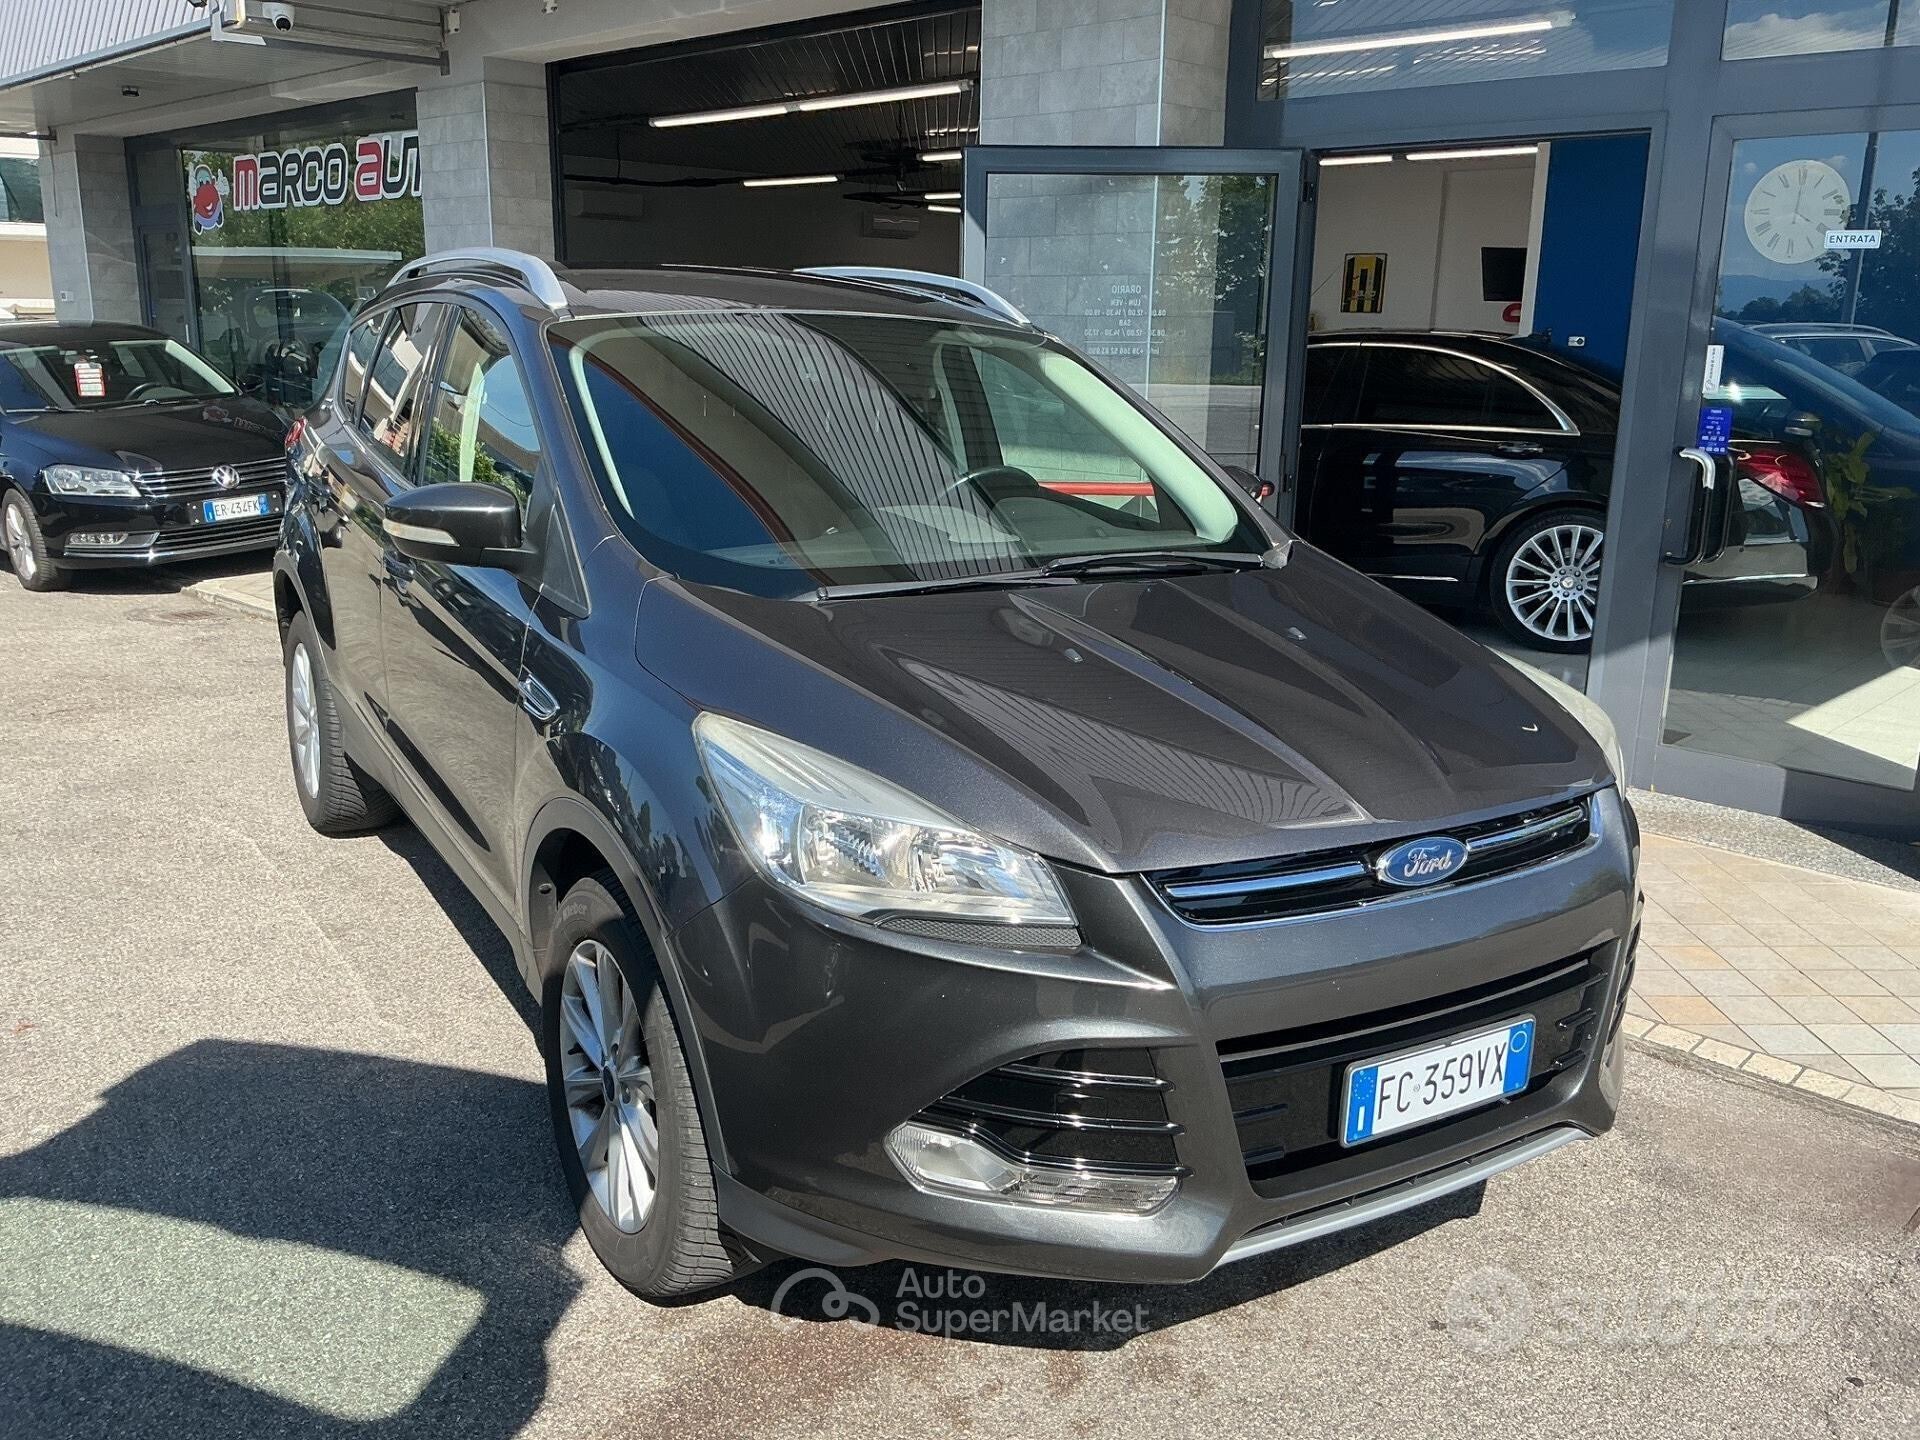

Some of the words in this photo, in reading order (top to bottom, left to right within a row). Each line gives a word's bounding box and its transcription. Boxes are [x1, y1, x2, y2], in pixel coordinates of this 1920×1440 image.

[1828, 234, 1877, 244] ENTRATA
[214, 502, 228, 517] ER
[230, 500, 259, 515] 434FK
[1403, 845, 1453, 878] Ford
[1377, 1071, 1414, 1120] FC
[1422, 1041, 1508, 1106] 359VX
